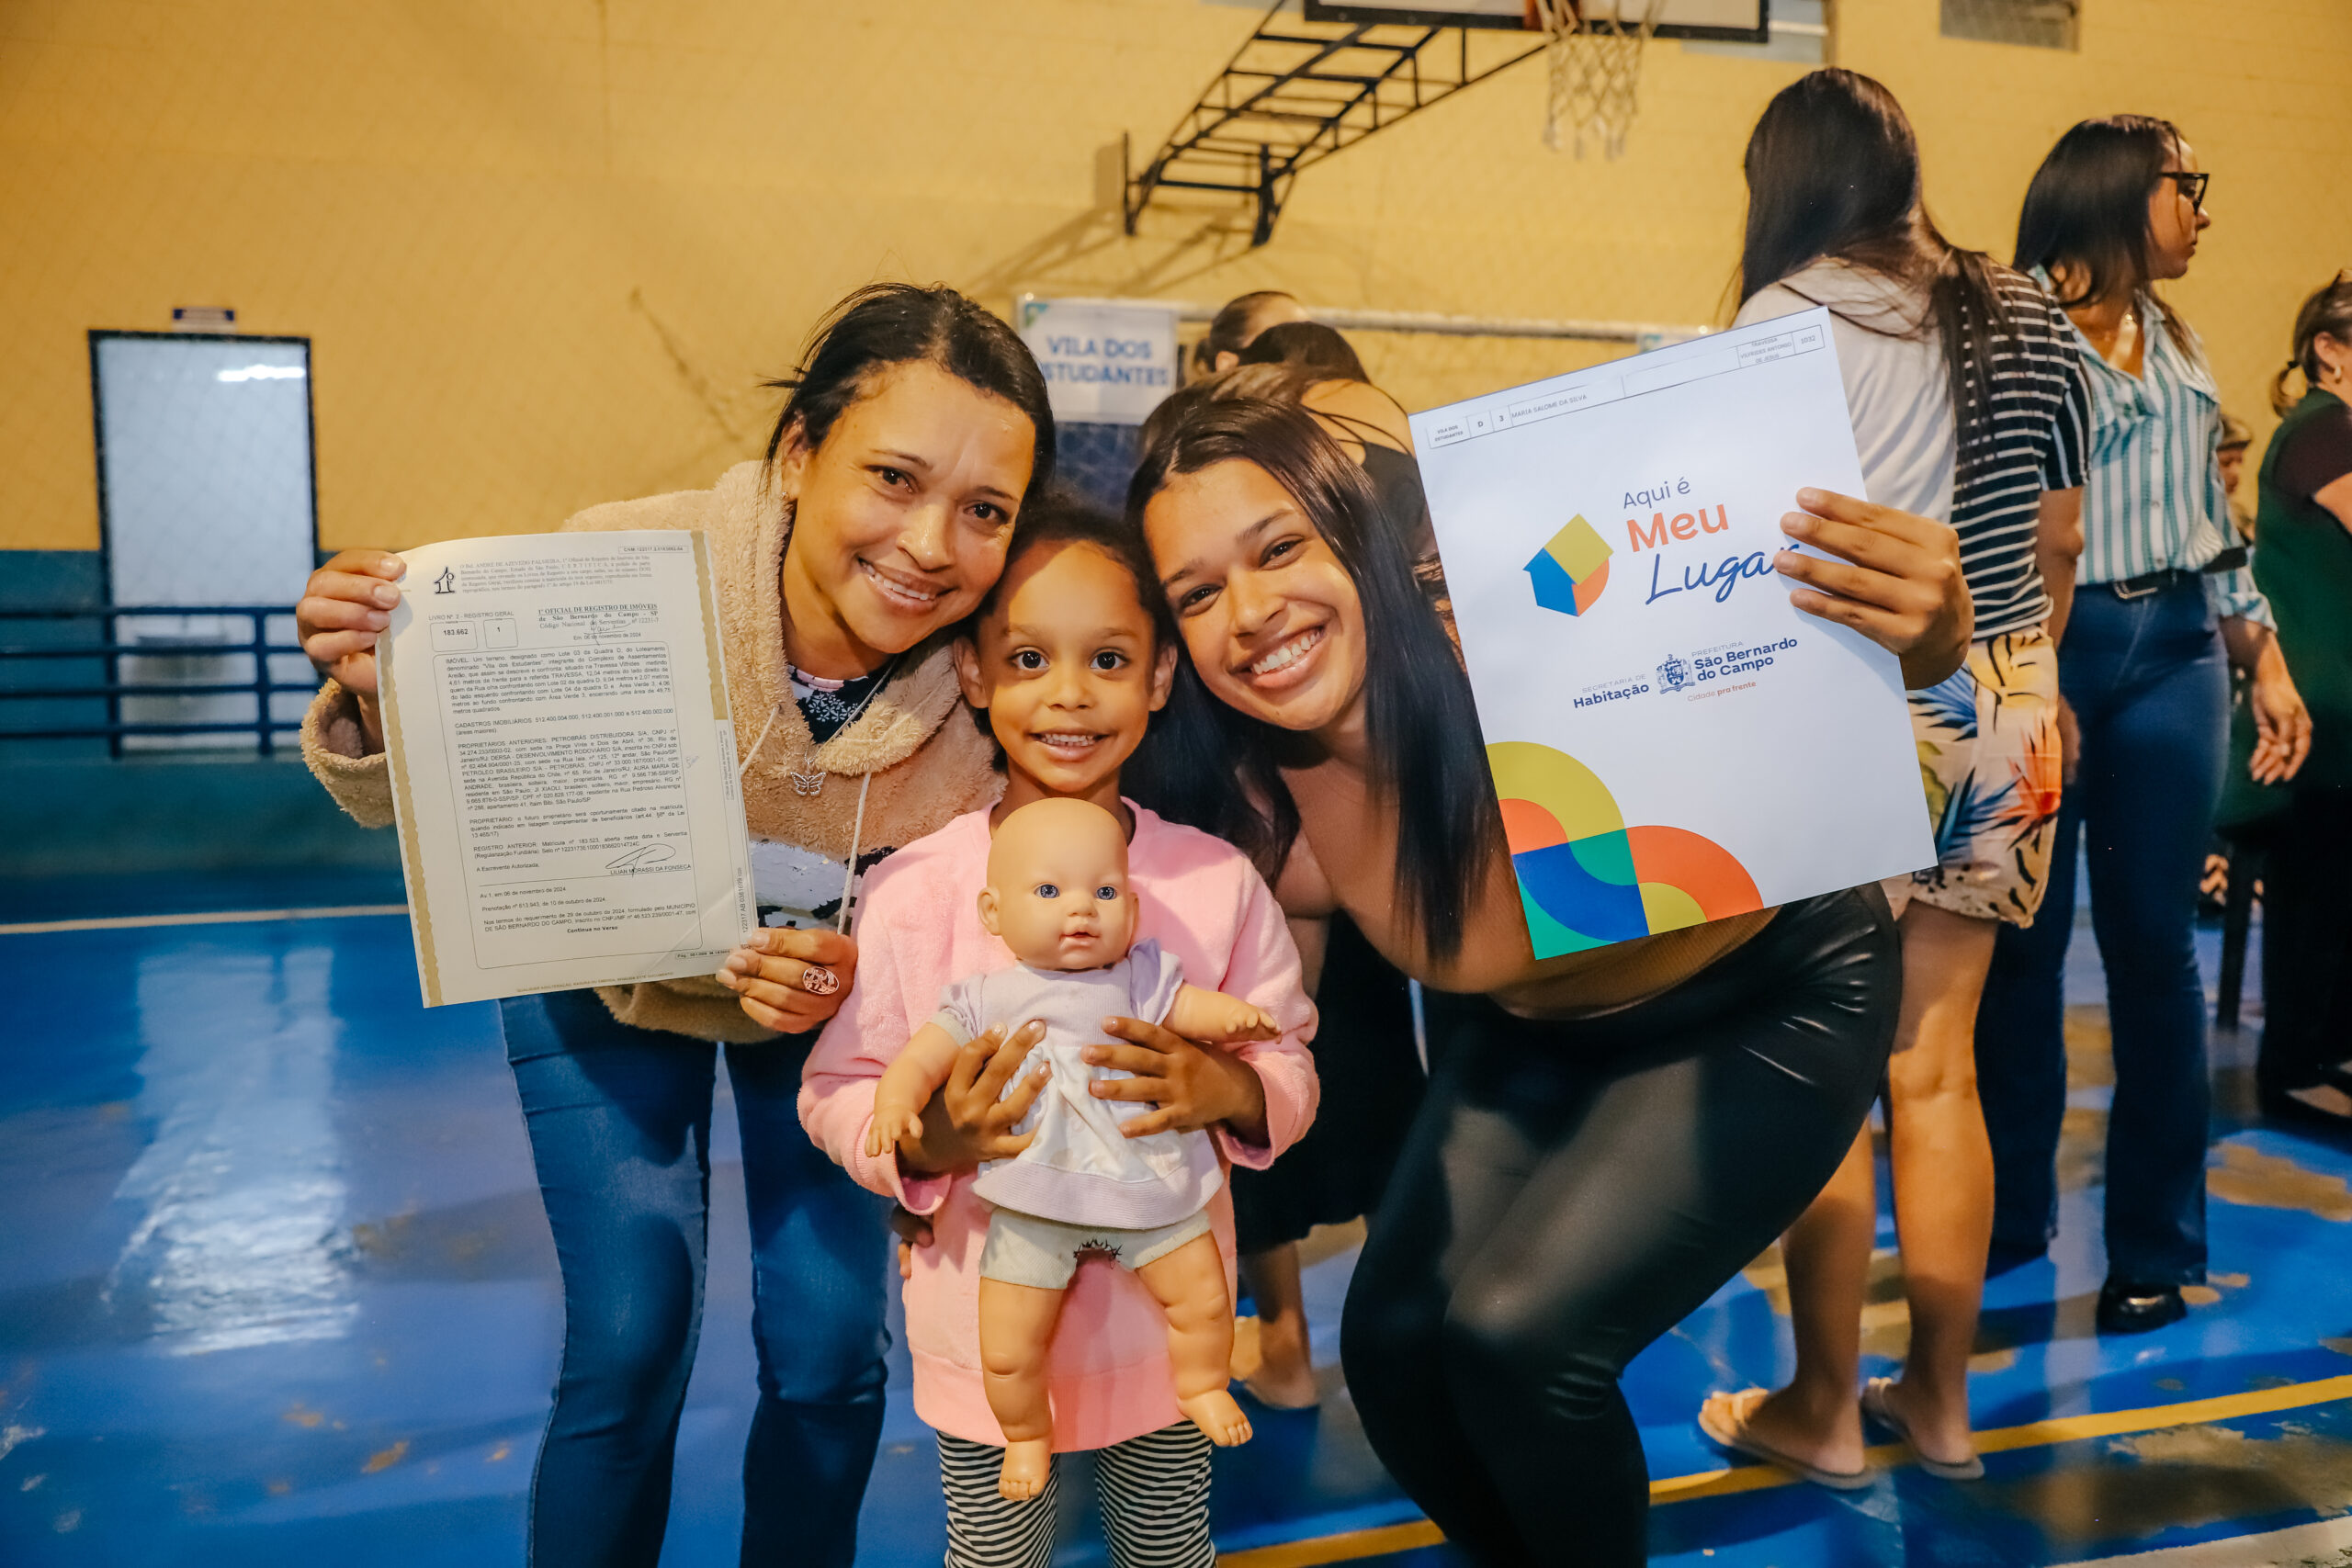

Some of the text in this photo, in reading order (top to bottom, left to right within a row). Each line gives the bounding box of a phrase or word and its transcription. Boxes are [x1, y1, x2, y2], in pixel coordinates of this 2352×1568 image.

[1046, 335, 1152, 359] VILA DOS
[1801, 335, 1816, 344] 1032
[1043, 363, 1169, 385] STUDANTES
[1512, 408, 1532, 419] MARIA
[1534, 401, 1558, 413] SALOME
[1569, 394, 1587, 403] SILVA
[1624, 477, 1691, 509] Aqui é
[1626, 504, 1729, 552] Meu
[1691, 640, 1744, 657] PREFEITURA
[1694, 637, 1798, 670] São Bernardo
[1697, 655, 1774, 681] do Campo
[1573, 682, 1650, 709] Habitação
[1582, 677, 1634, 693] SECRETARIA
[1687, 680, 1757, 702] Cidade pra frente
